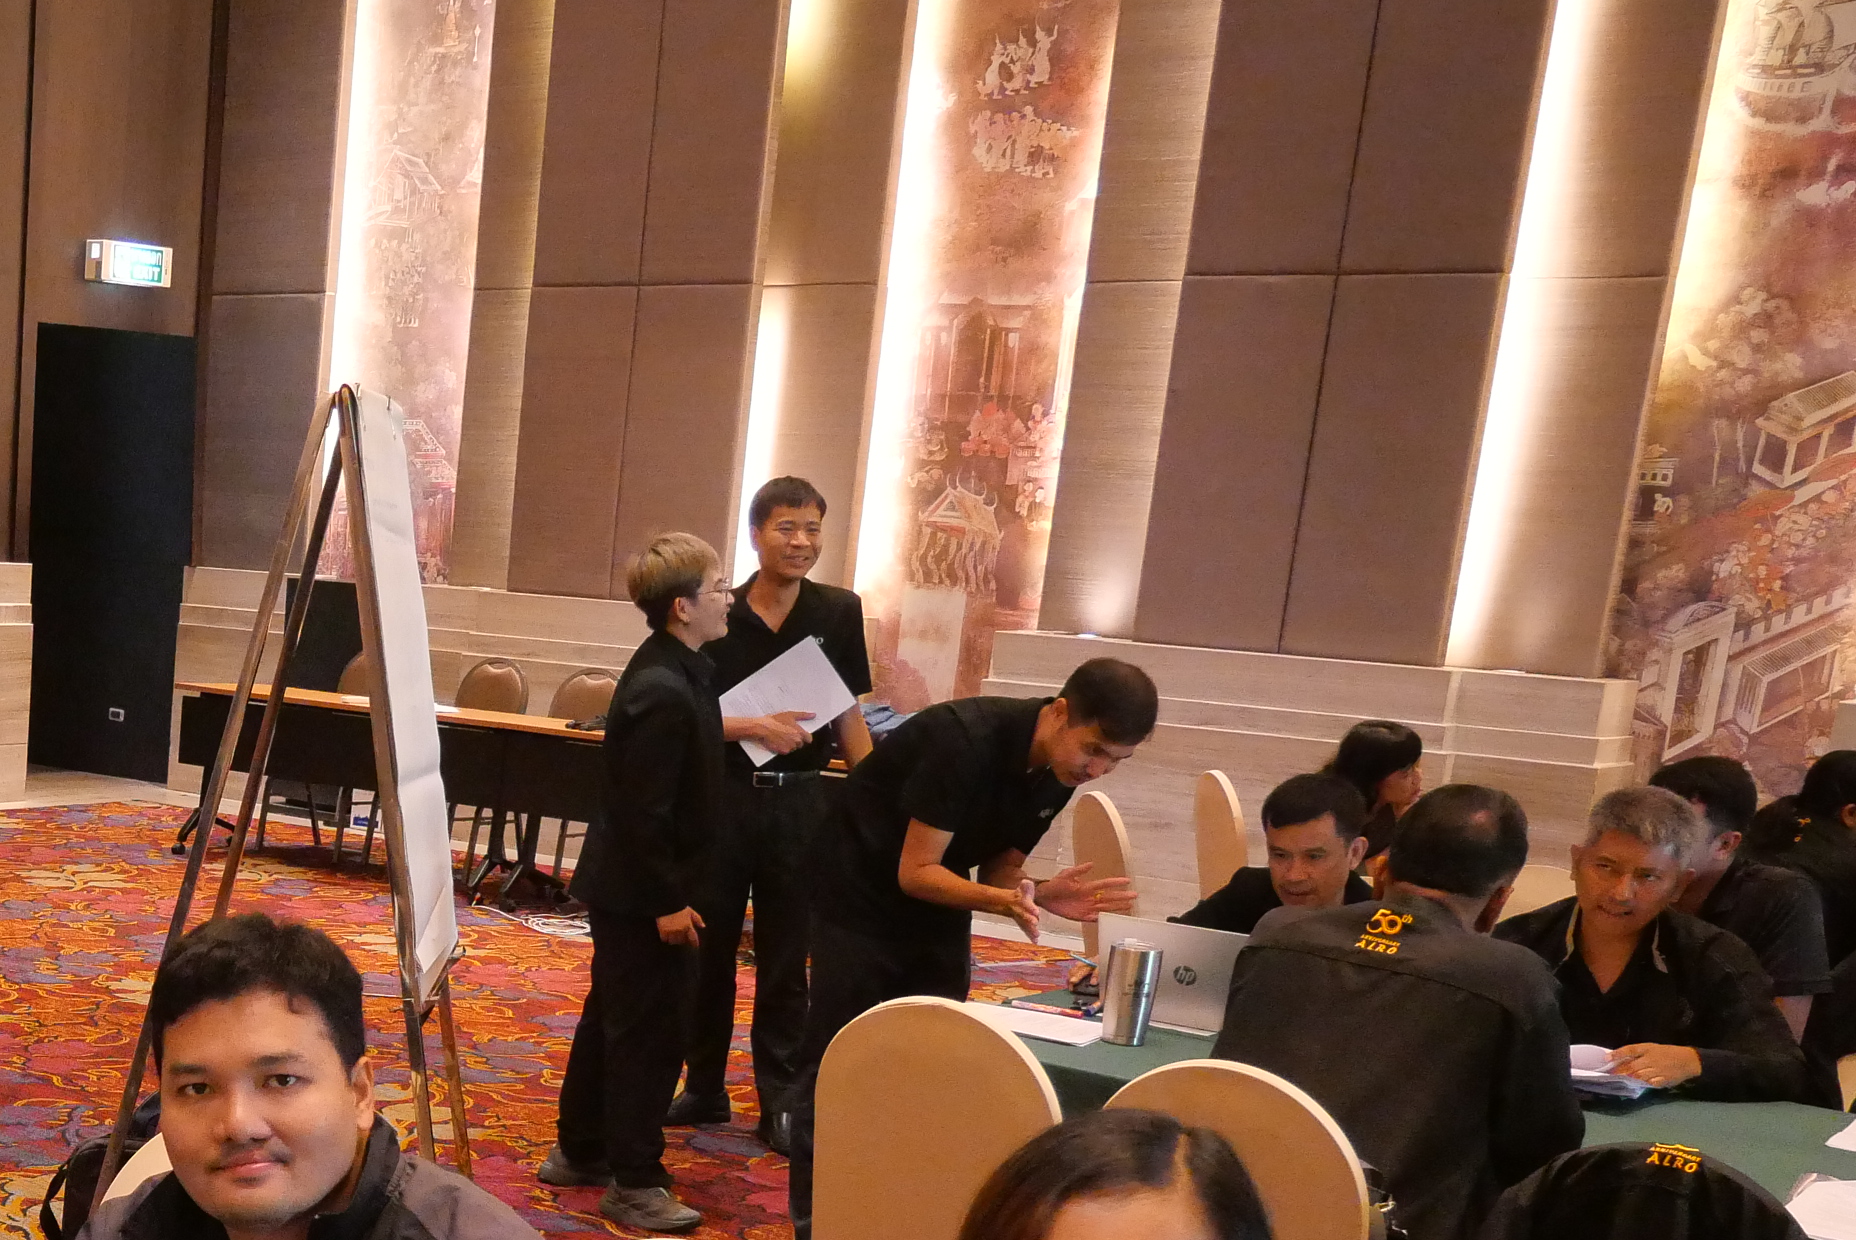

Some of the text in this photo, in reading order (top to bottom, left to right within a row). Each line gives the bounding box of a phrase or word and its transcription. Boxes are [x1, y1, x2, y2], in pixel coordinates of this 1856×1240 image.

[1354, 939, 1398, 955] ALRO
[1175, 965, 1196, 987] hp
[1645, 1151, 1699, 1173] ALRO
